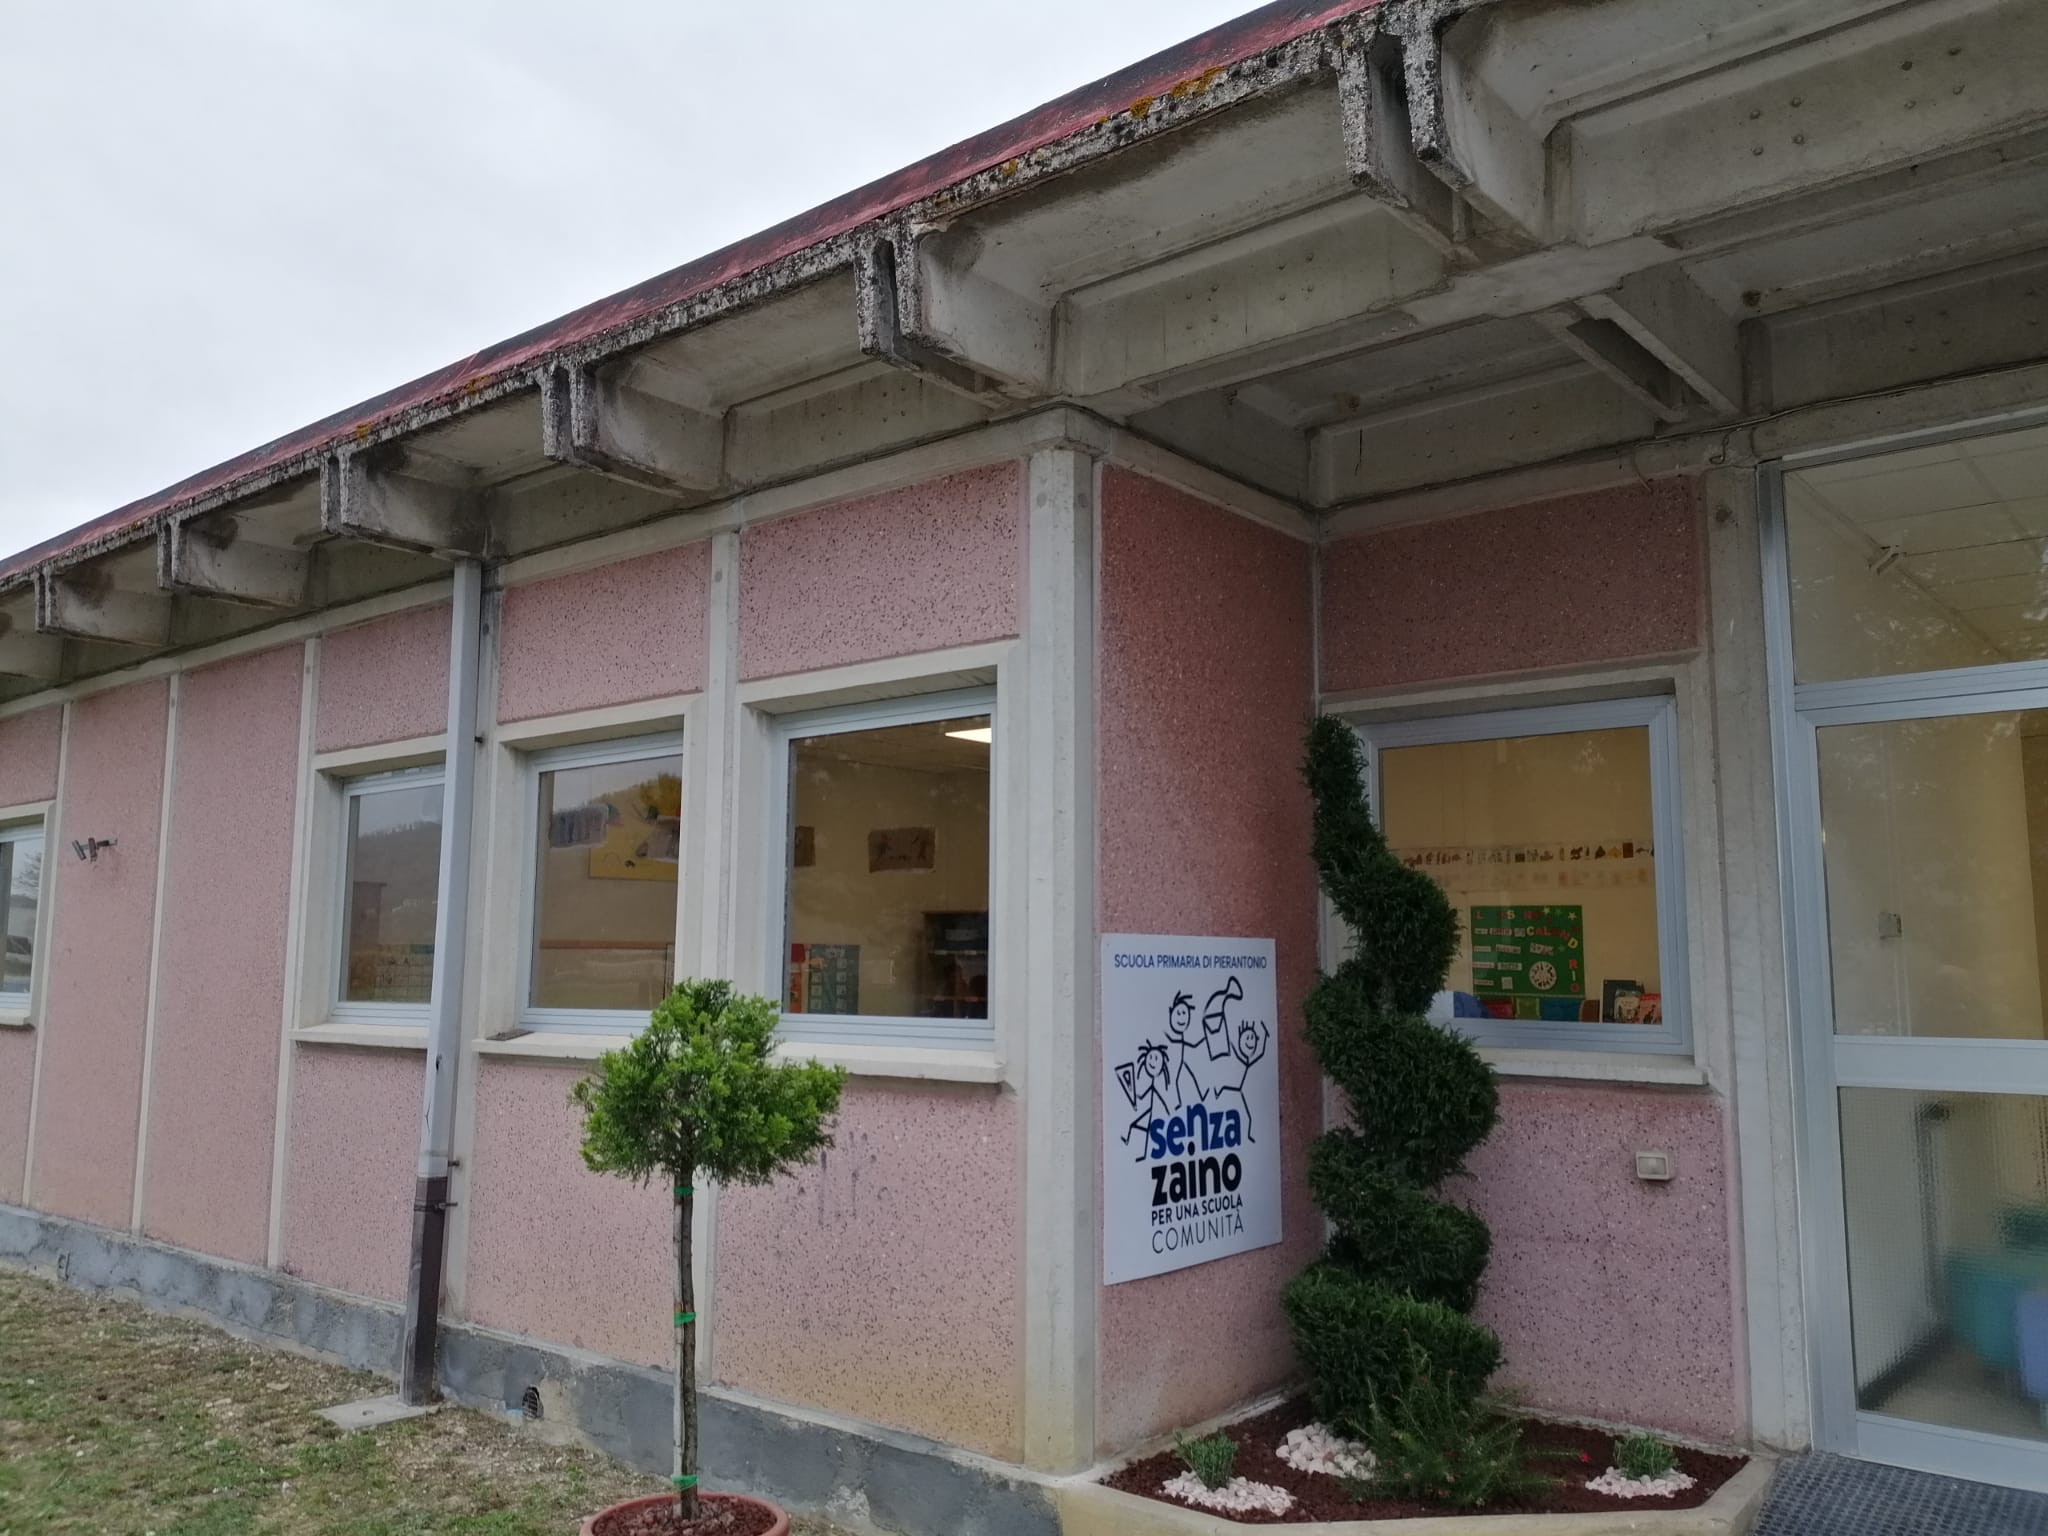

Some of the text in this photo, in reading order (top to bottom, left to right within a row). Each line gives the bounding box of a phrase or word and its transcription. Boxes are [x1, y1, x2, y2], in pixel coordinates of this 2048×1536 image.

[1114, 954, 1267, 969] SCUOLA PRIMARIA DI PIERANTONIO
[1150, 1103, 1241, 1159] senza
[1151, 1141, 1242, 1207] zaino
[1152, 1194, 1243, 1227] PER UNA SCUOLA
[1152, 1209, 1244, 1254] COMUNITÀ
